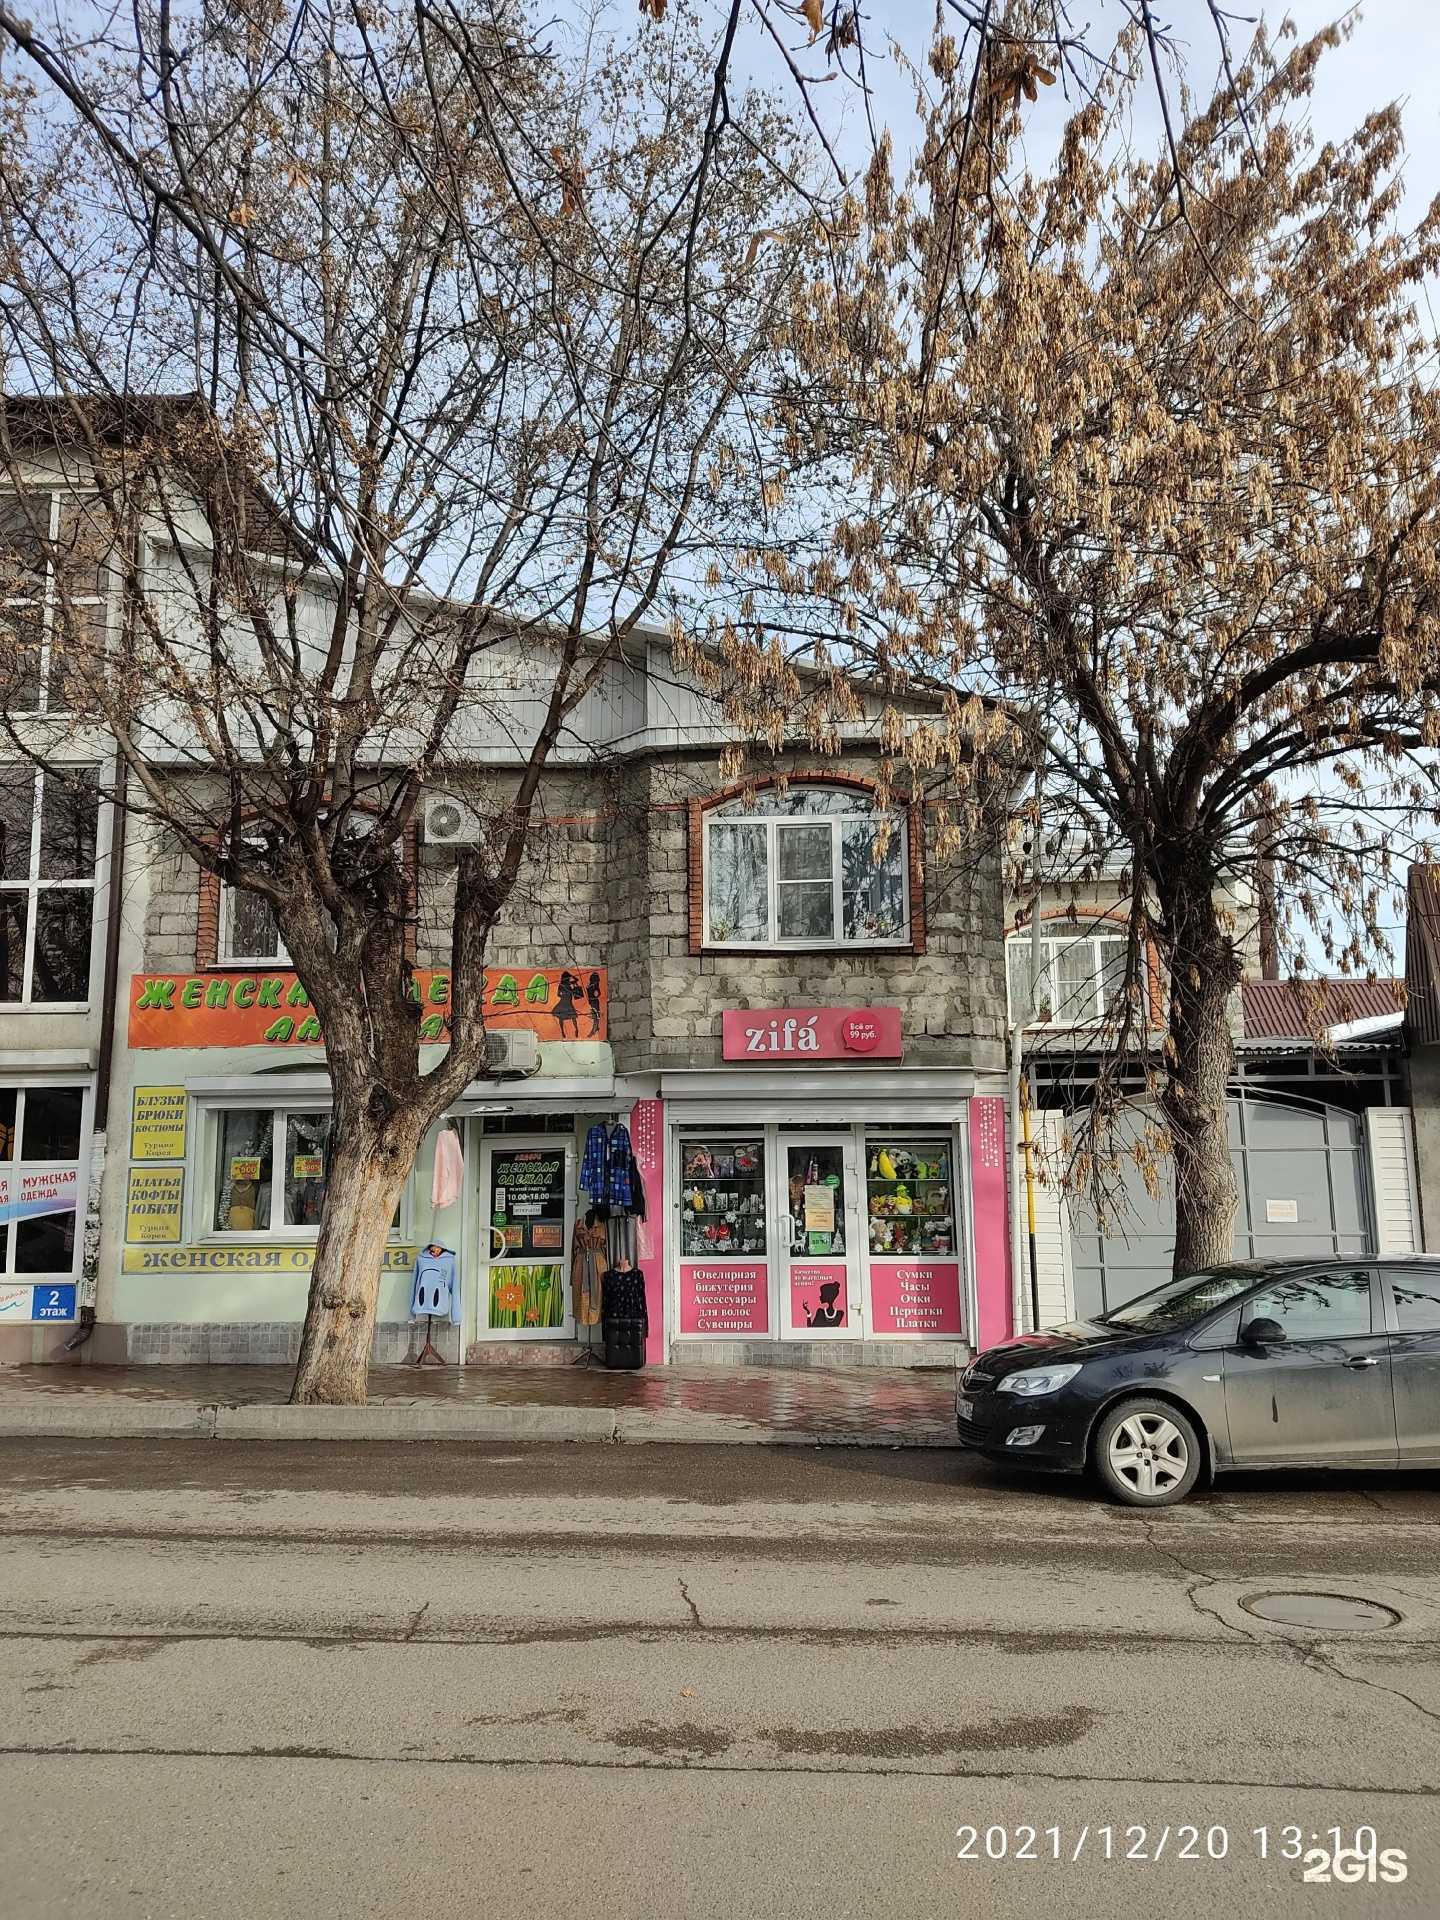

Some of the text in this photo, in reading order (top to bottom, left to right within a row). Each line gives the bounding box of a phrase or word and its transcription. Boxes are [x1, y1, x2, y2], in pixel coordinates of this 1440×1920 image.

[136, 979, 311, 1009] ЖЕНСКА
[849, 1030, 860, 1038] 99
[136, 1095, 185, 1106] БЛУЗКИ
[136, 1109, 184, 1120] БРЮКИ
[497, 1161, 560, 1174] ЖЕНСКАЯ
[22, 1171, 77, 1189] МУЖСКАЯ
[131, 1178, 181, 1187] ПЛАТЬЯ
[498, 1173, 553, 1186] ОДЕЖДА
[20, 1188, 58, 1201] ОДЕЖДА
[131, 1190, 180, 1200] КОФТЫ
[131, 1203, 179, 1214] ЮБКИ
[143, 1250, 281, 1268] женская
[692, 1270, 757, 1281] Ювелирная
[896, 1269, 933, 1281] Сумки
[695, 1283, 753, 1293] бижутерия
[900, 1281, 930, 1291] Часы
[49, 1290, 60, 1306] 2
[693, 1295, 757, 1306] Аксессуары
[900, 1294, 931, 1303] Очки
[39, 1307, 68, 1317] этаж
[698, 1309, 718, 1317] для
[890, 1306, 943, 1318] Перчатки
[697, 1319, 753, 1331] Сувениры
[896, 1318, 937, 1328] Платки
